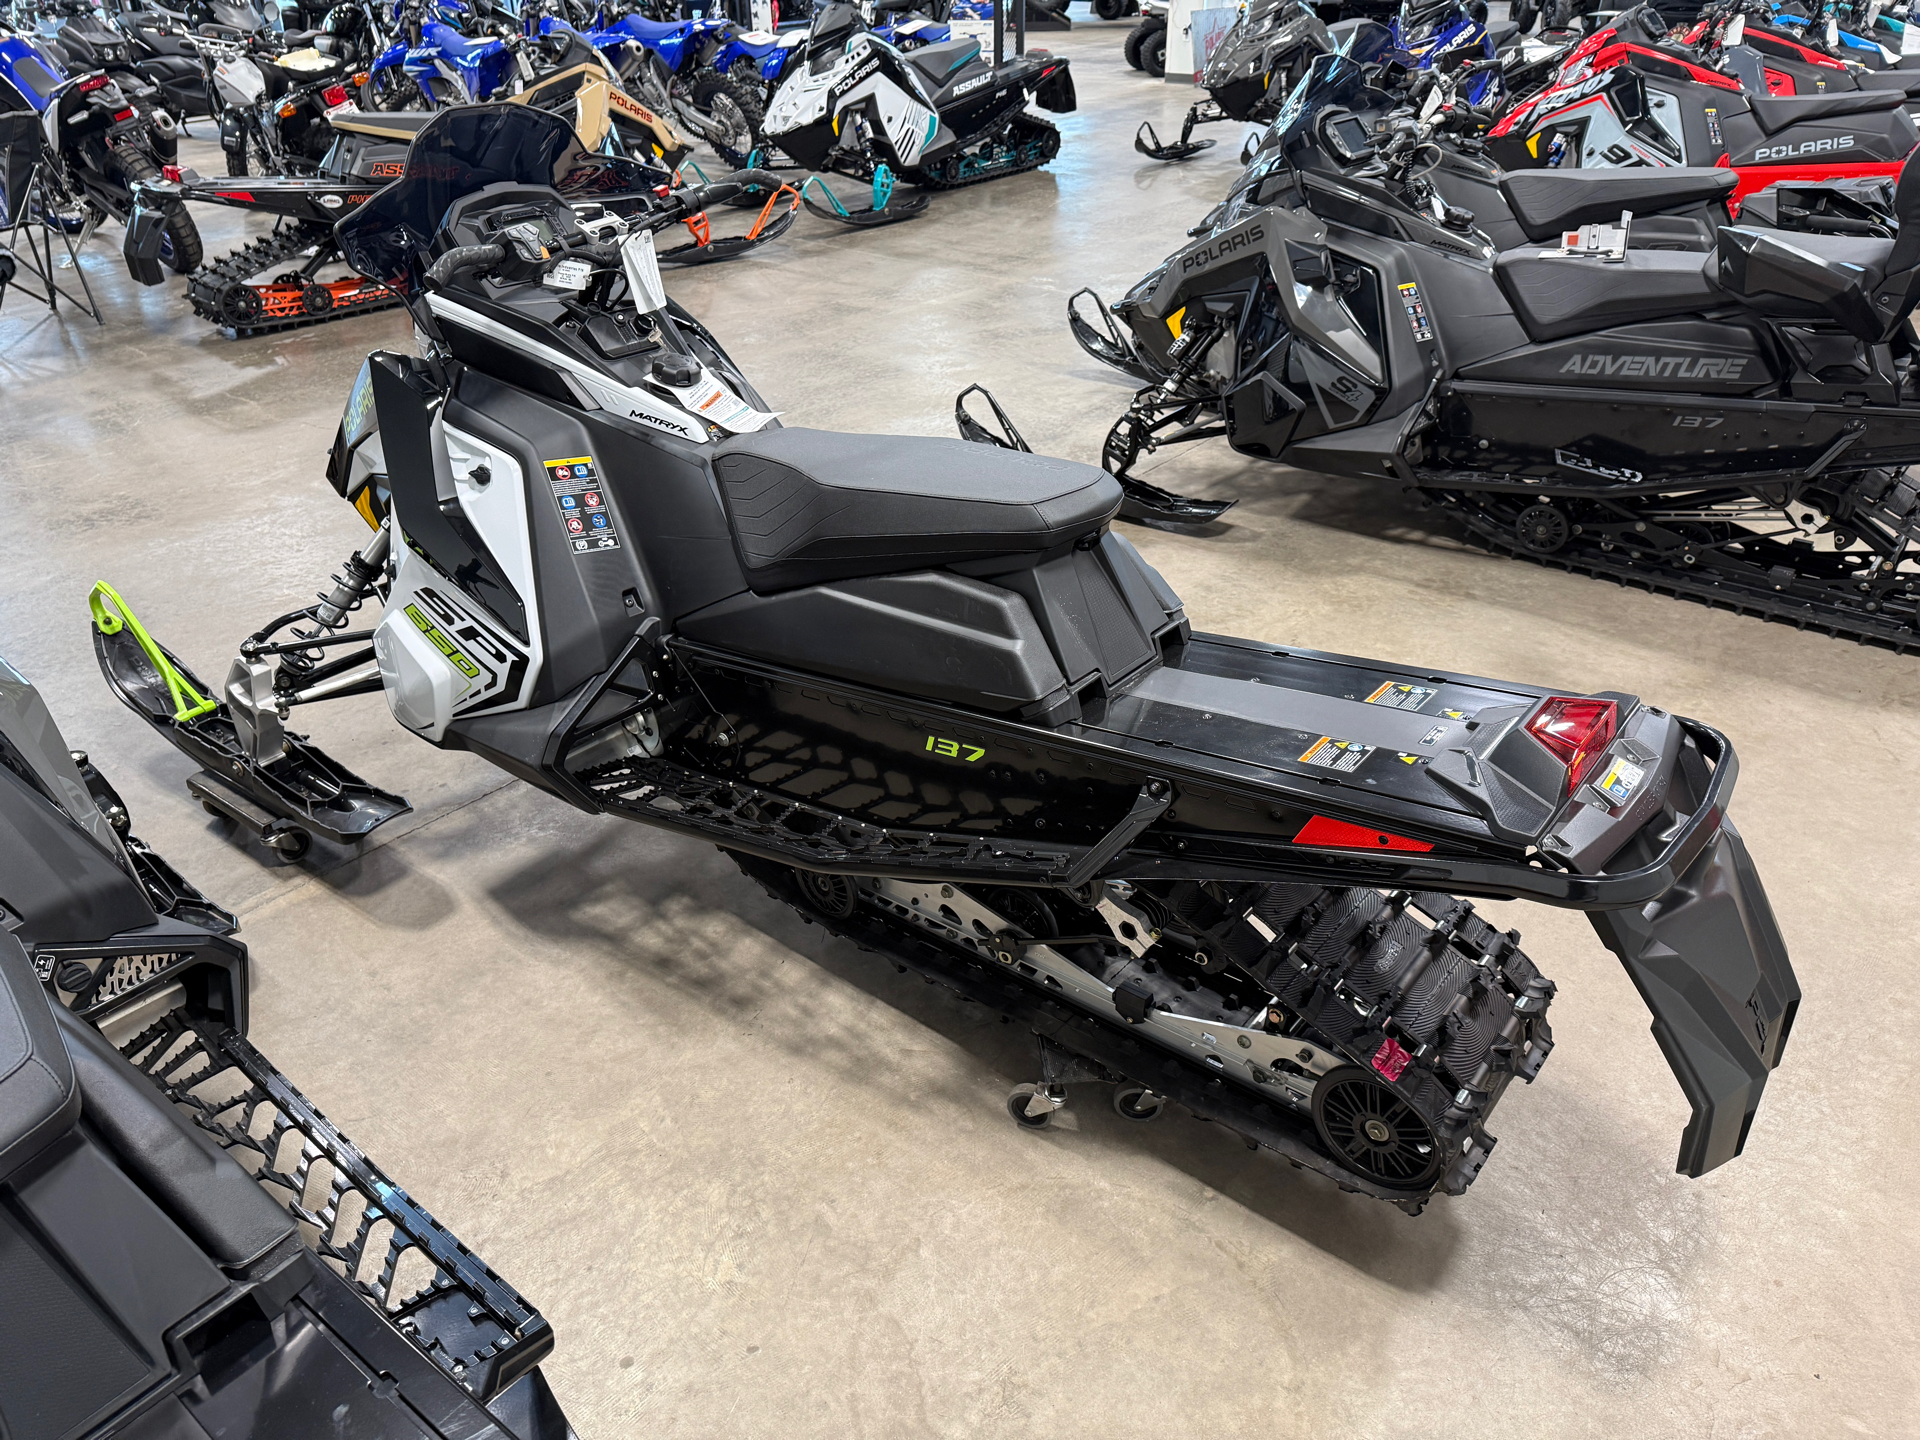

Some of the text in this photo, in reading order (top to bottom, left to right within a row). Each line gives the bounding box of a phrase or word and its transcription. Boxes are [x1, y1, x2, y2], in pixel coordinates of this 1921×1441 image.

[1433, 23, 1477, 58] OLARIS
[833, 57, 880, 97] POLARIS
[952, 71, 993, 98] ASSAULT
[609, 91, 654, 123] POLARIS
[1754, 135, 1855, 161] POLARIS
[1182, 224, 1265, 273] POLARIS
[1430, 239, 1471, 255] MATRYX
[1559, 354, 1749, 379] ADVENTURE
[629, 409, 688, 436] MATRYX
[1672, 415, 1725, 428] 137
[413, 586, 508, 665] SP
[403, 602, 481, 679] 650
[925, 735, 986, 762] 137
